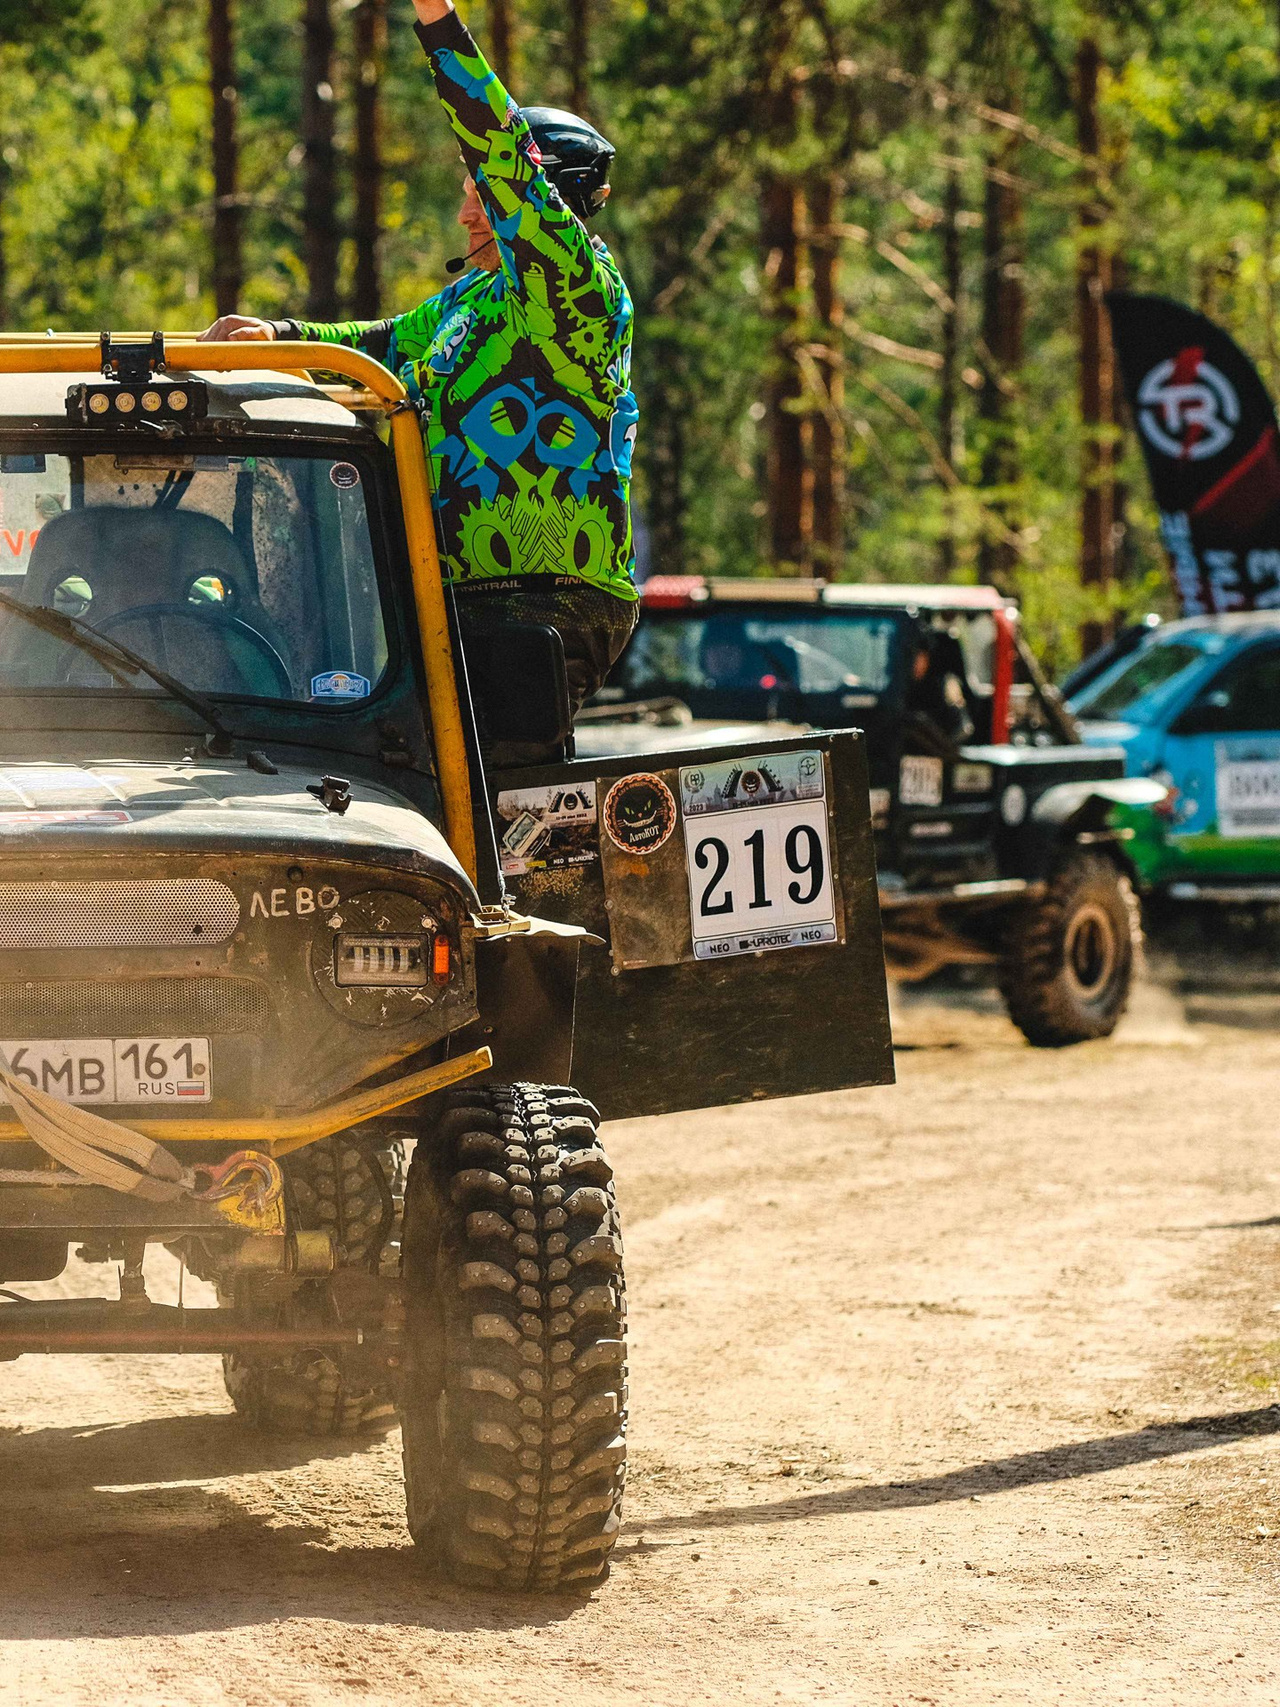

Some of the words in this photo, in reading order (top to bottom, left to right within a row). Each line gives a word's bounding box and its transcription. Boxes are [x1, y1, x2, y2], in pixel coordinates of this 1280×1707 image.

[629, 825, 660, 843] АвтоКОТ
[694, 824, 824, 917] 219
[250, 886, 340, 919] ЛЕВО
[709, 942, 730, 954] NEO
[801, 930, 822, 941] NEO
[121, 1043, 193, 1080] 161
[138, 1082, 175, 1096] RUS
